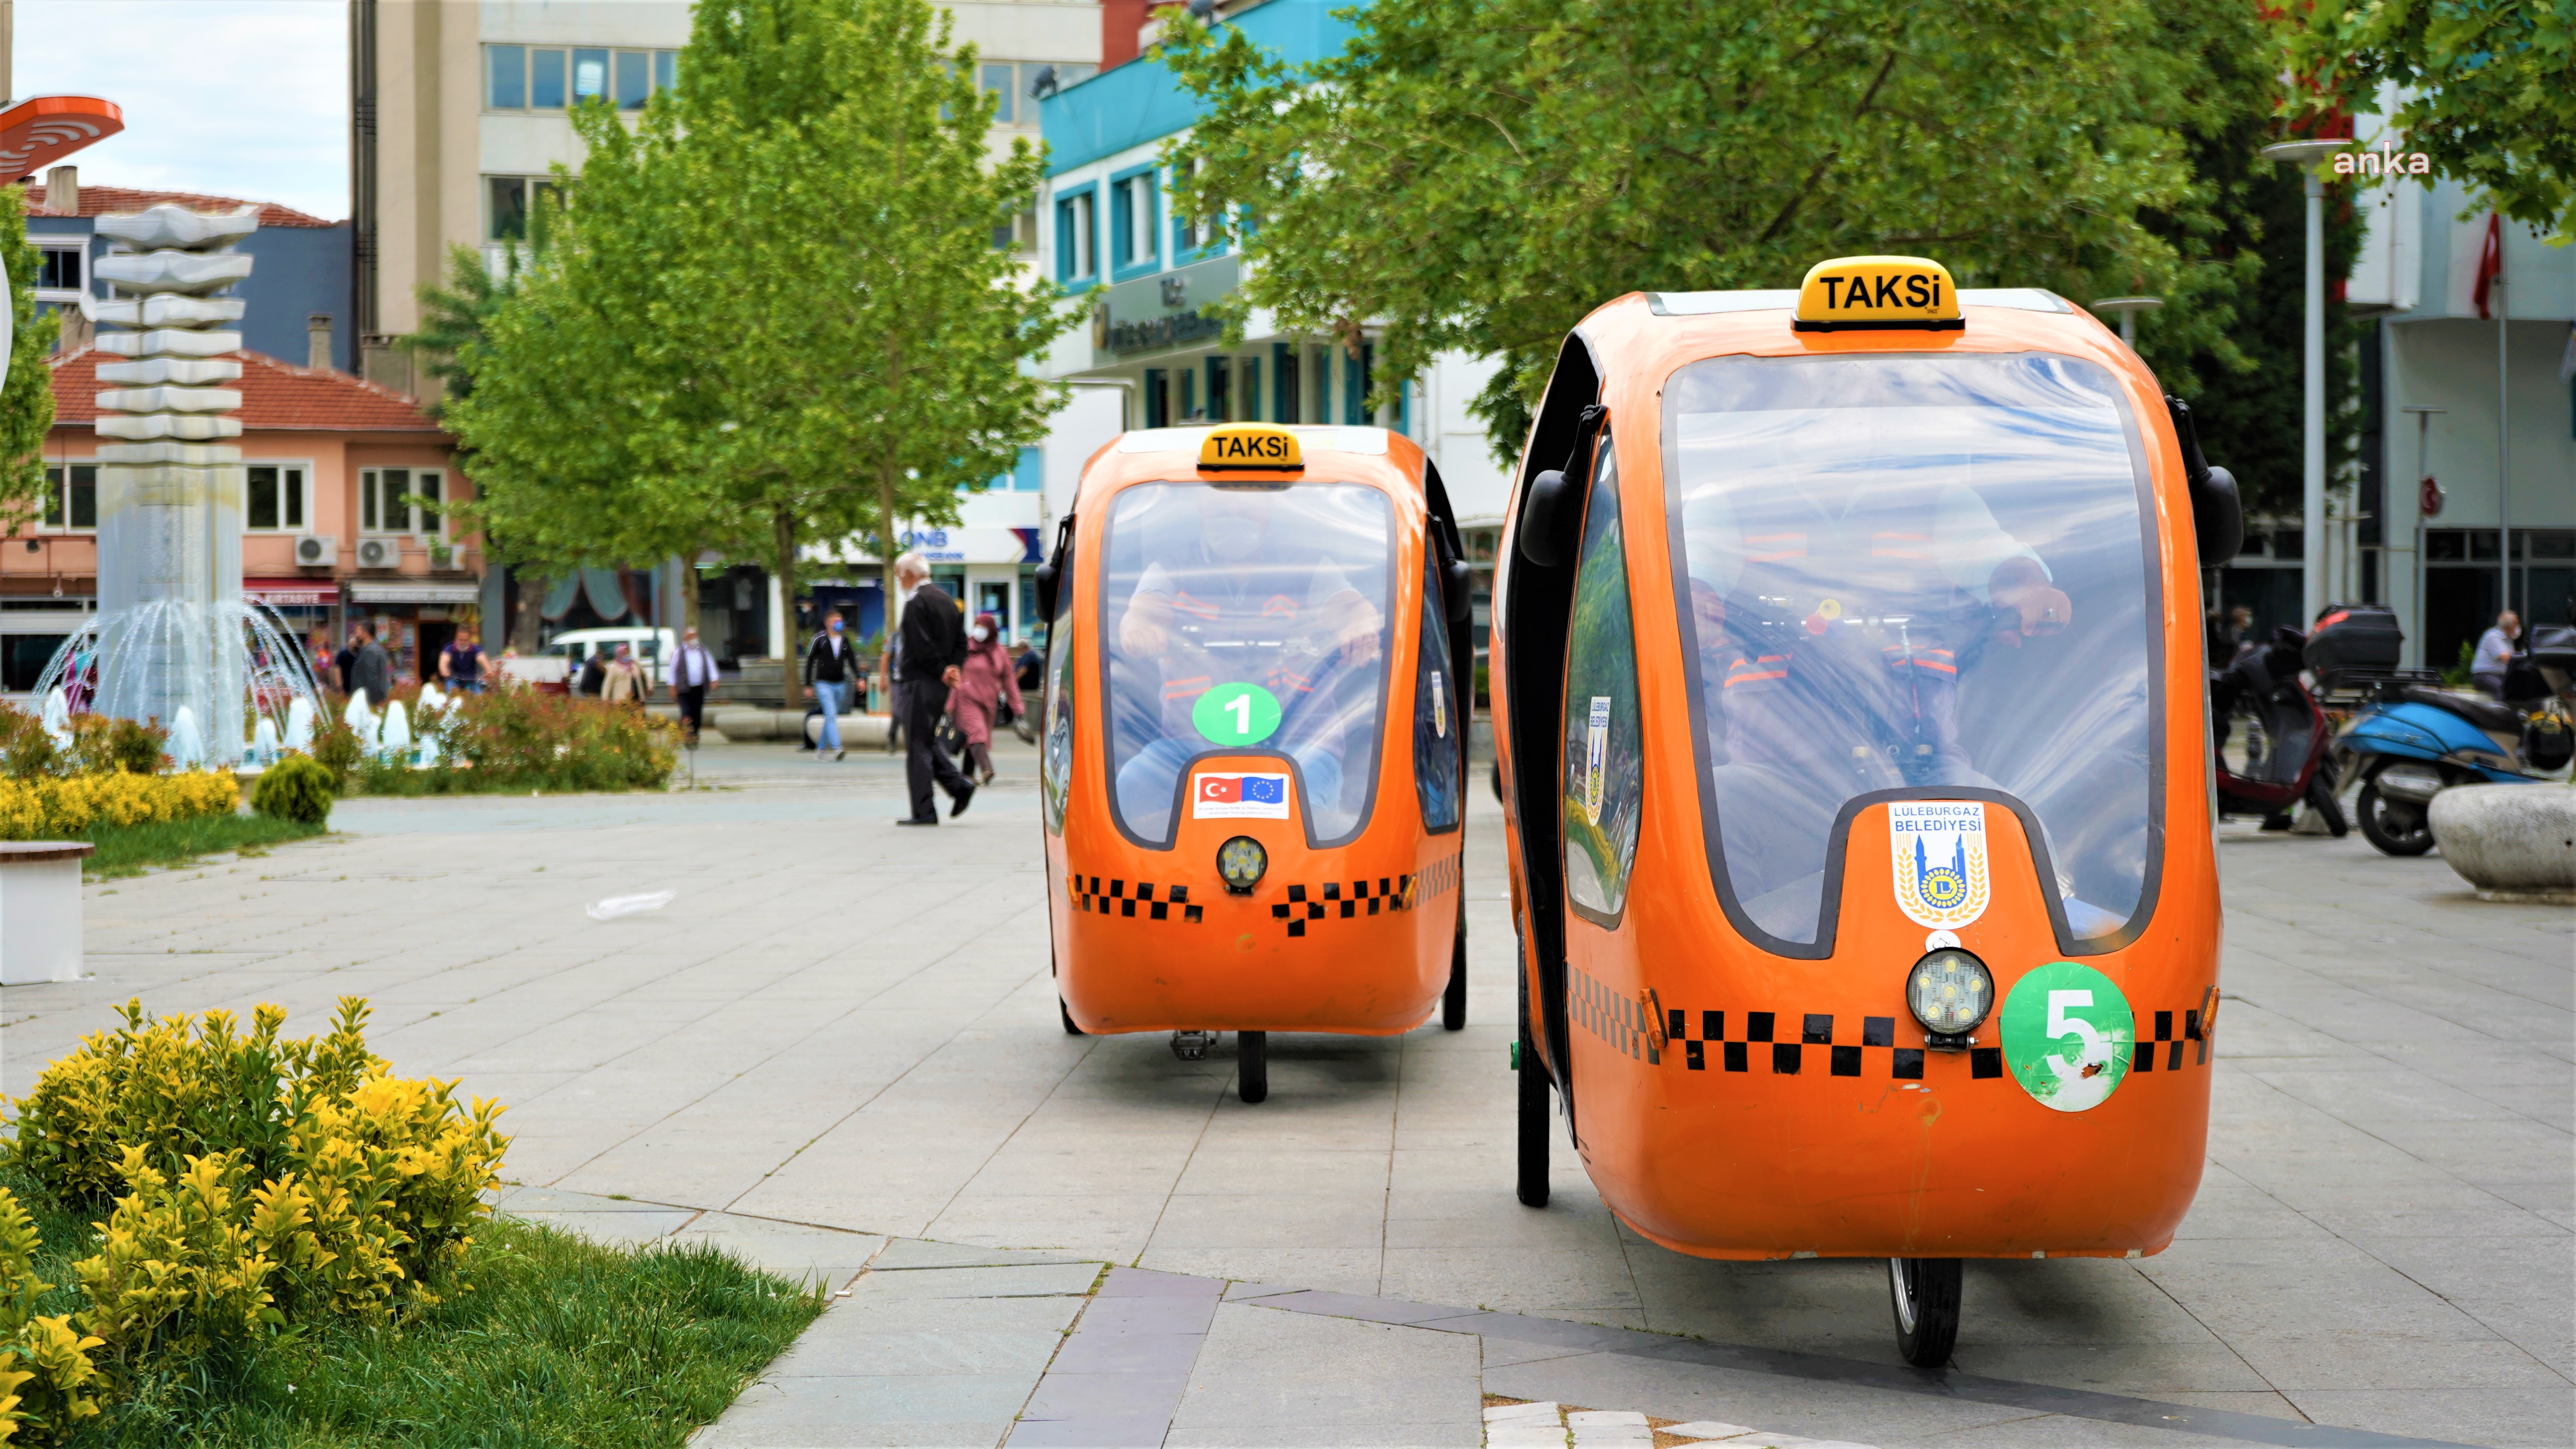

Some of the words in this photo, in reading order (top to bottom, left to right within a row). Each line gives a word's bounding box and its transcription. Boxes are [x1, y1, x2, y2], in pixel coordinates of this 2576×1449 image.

[1591, 700, 1609, 711] LÜLEBURGAZ
[1224, 694, 1250, 734] 1
[1590, 713, 1608, 728] BELEDİYESİ
[1894, 805, 1980, 816] LÜLEBURGAZ
[1895, 818, 1981, 831] BELEDİYESİ
[2046, 989, 2104, 1084] 5
